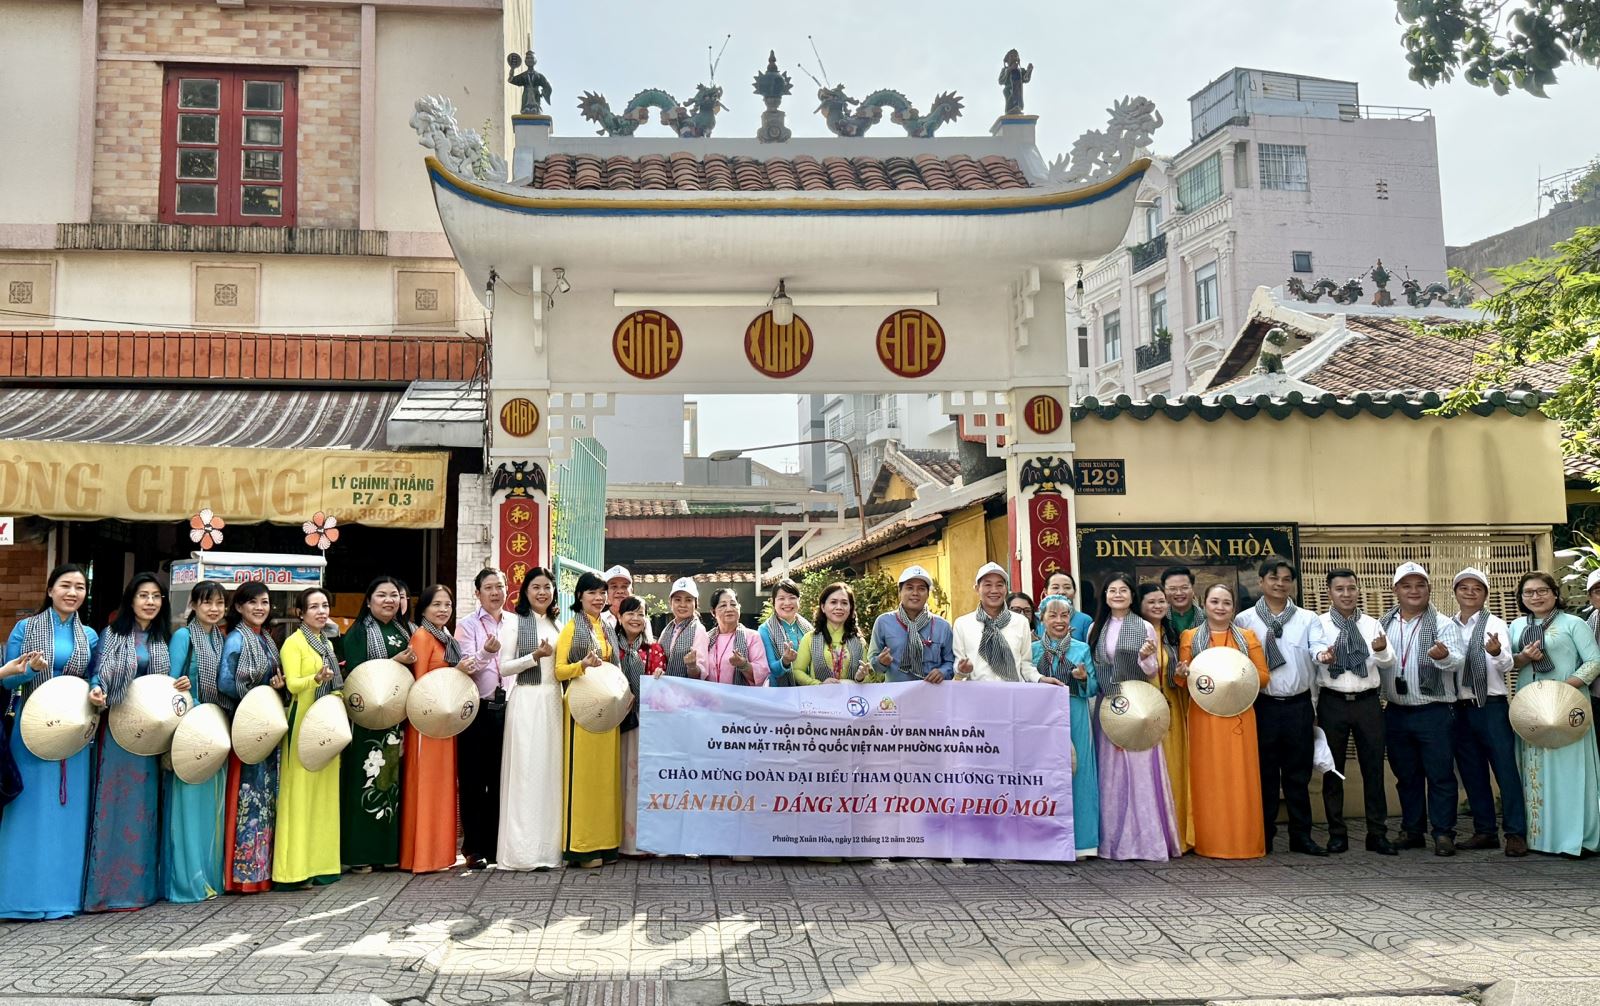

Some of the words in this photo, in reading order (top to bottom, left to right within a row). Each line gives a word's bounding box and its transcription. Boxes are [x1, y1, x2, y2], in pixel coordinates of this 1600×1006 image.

[356, 459, 413, 473] 129
[331, 474, 347, 490] LÝ
[350, 474, 389, 490] CHÍNH
[392, 473, 434, 491] THẮNG
[1081, 468, 1119, 486] 129
[126, 464, 309, 516] GIANG
[352, 492, 374, 505] P.7
[388, 493, 412, 506] Q.3
[1095, 535, 1154, 557] ĐÌNH
[1158, 533, 1222, 557] XUÂN
[1228, 533, 1277, 557] HÒA
[721, 722, 751, 734] ĐẢNG
[753, 723, 768, 734] ỦY
[775, 724, 795, 738] HỘI
[797, 722, 828, 736] ĐỒNG
[830, 725, 860, 736] NHÂN
[862, 725, 884, 737] DÂN
[890, 725, 904, 737] ỦY
[905, 728, 927, 737] BAN
[928, 726, 960, 738] NHÂN
[962, 726, 985, 738] DÂN
[707, 738, 723, 750] ỦY
[724, 741, 746, 750] BAN
[748, 739, 770, 753] MẶT
[772, 739, 800, 753] TRẬN
[802, 738, 816, 752] TỔ
[818, 738, 849, 753] QUỐC
[850, 741, 871, 755] VIỆT
[873, 743, 896, 753] NAM
[898, 740, 942, 753] PHƯỜNG
[944, 742, 974, 754] XUÂN
[975, 742, 1000, 754] HÒA
[658, 767, 699, 780] CHÀO
[701, 767, 743, 781] MỪNG
[745, 768, 785, 782] ĐOÀN
[788, 771, 813, 784] ĐẠI
[816, 768, 849, 783] BIỂU
[852, 772, 891, 784] THAM
[893, 773, 932, 785] QUAN
[934, 772, 994, 786] CHƯƠNG
[997, 772, 1044, 786] TRÌNH
[646, 790, 707, 811] XUÂN
[709, 791, 756, 812] HÒA
[772, 791, 832, 813] DÁNG
[836, 793, 878, 814] XƯA
[884, 795, 955, 815] TRONG
[960, 793, 1010, 816] PHỐ
[1012, 795, 1058, 817] MỚI
[772, 835, 798, 844] Phường
[799, 835, 818, 843] Xuân
[818, 835, 834, 844] Hòa,
[835, 836, 851, 845] ngày
[861, 835, 880, 844] tháng
